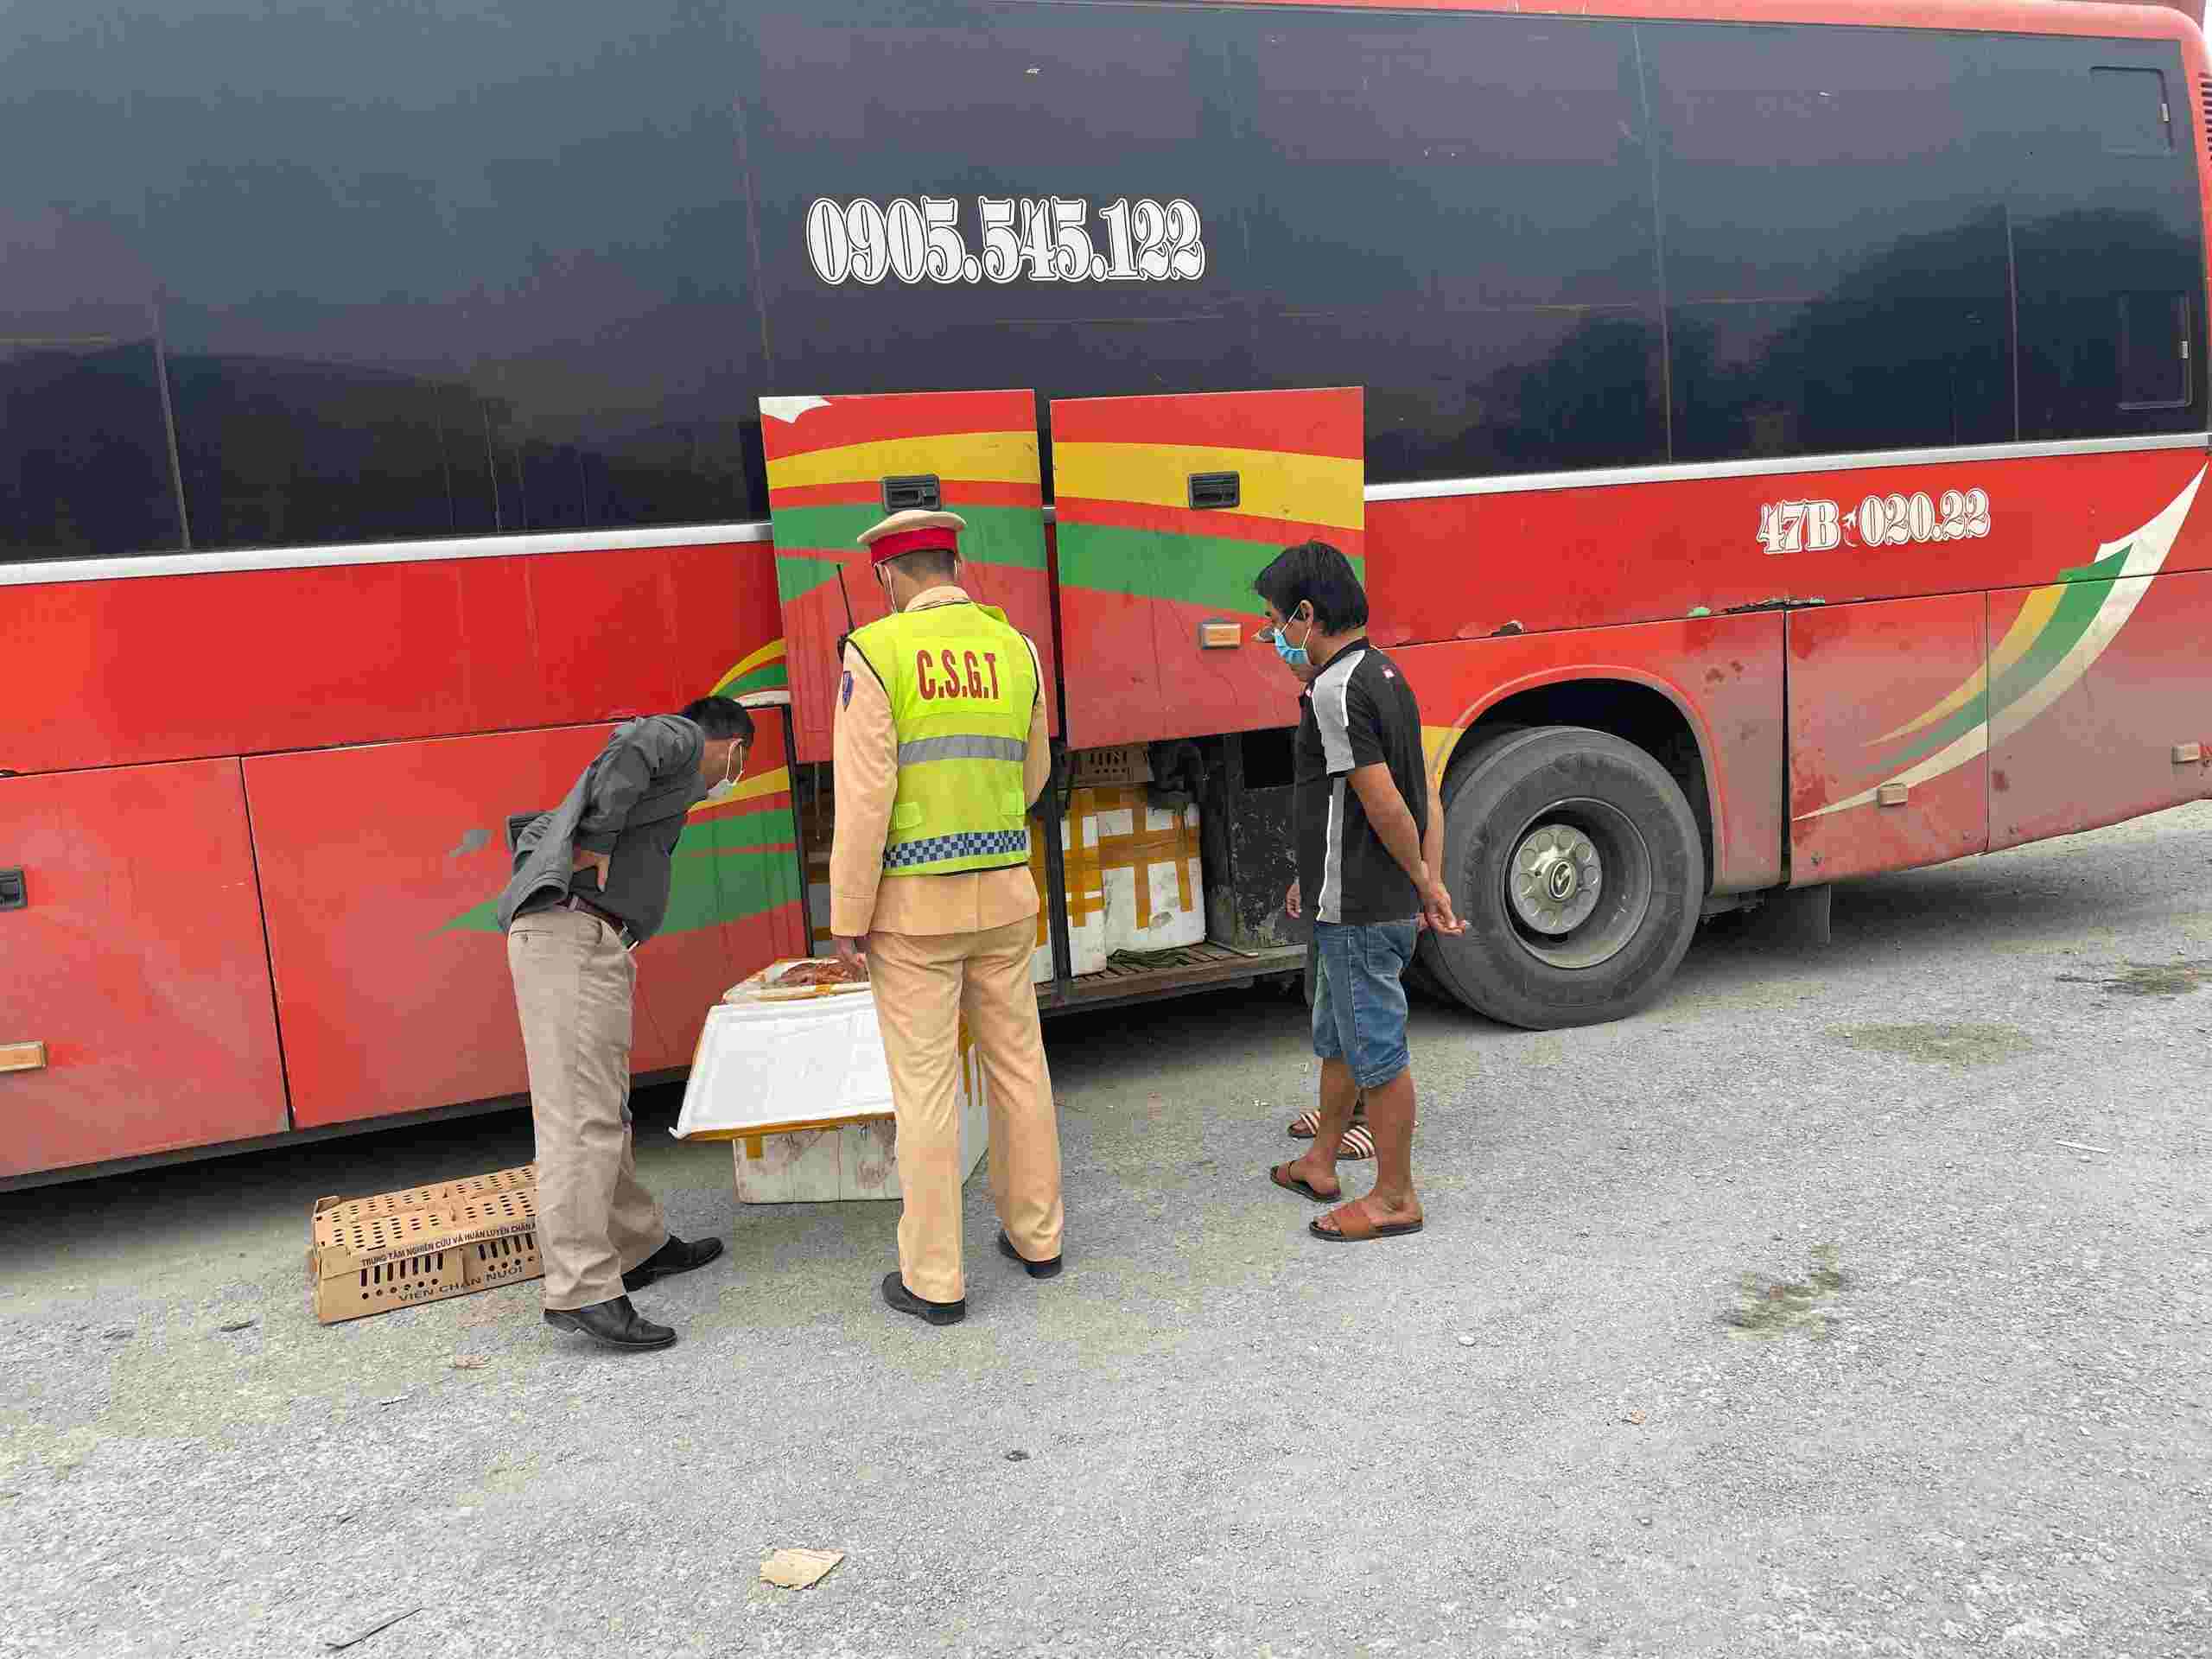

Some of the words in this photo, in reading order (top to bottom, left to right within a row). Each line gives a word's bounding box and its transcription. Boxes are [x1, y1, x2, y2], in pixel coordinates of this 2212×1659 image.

[806, 196, 1205, 284] 0905.545.122
[1756, 499, 1842, 554] 47B
[1859, 488, 1991, 547] 020.22
[916, 648, 1000, 701] C.S.G.T
